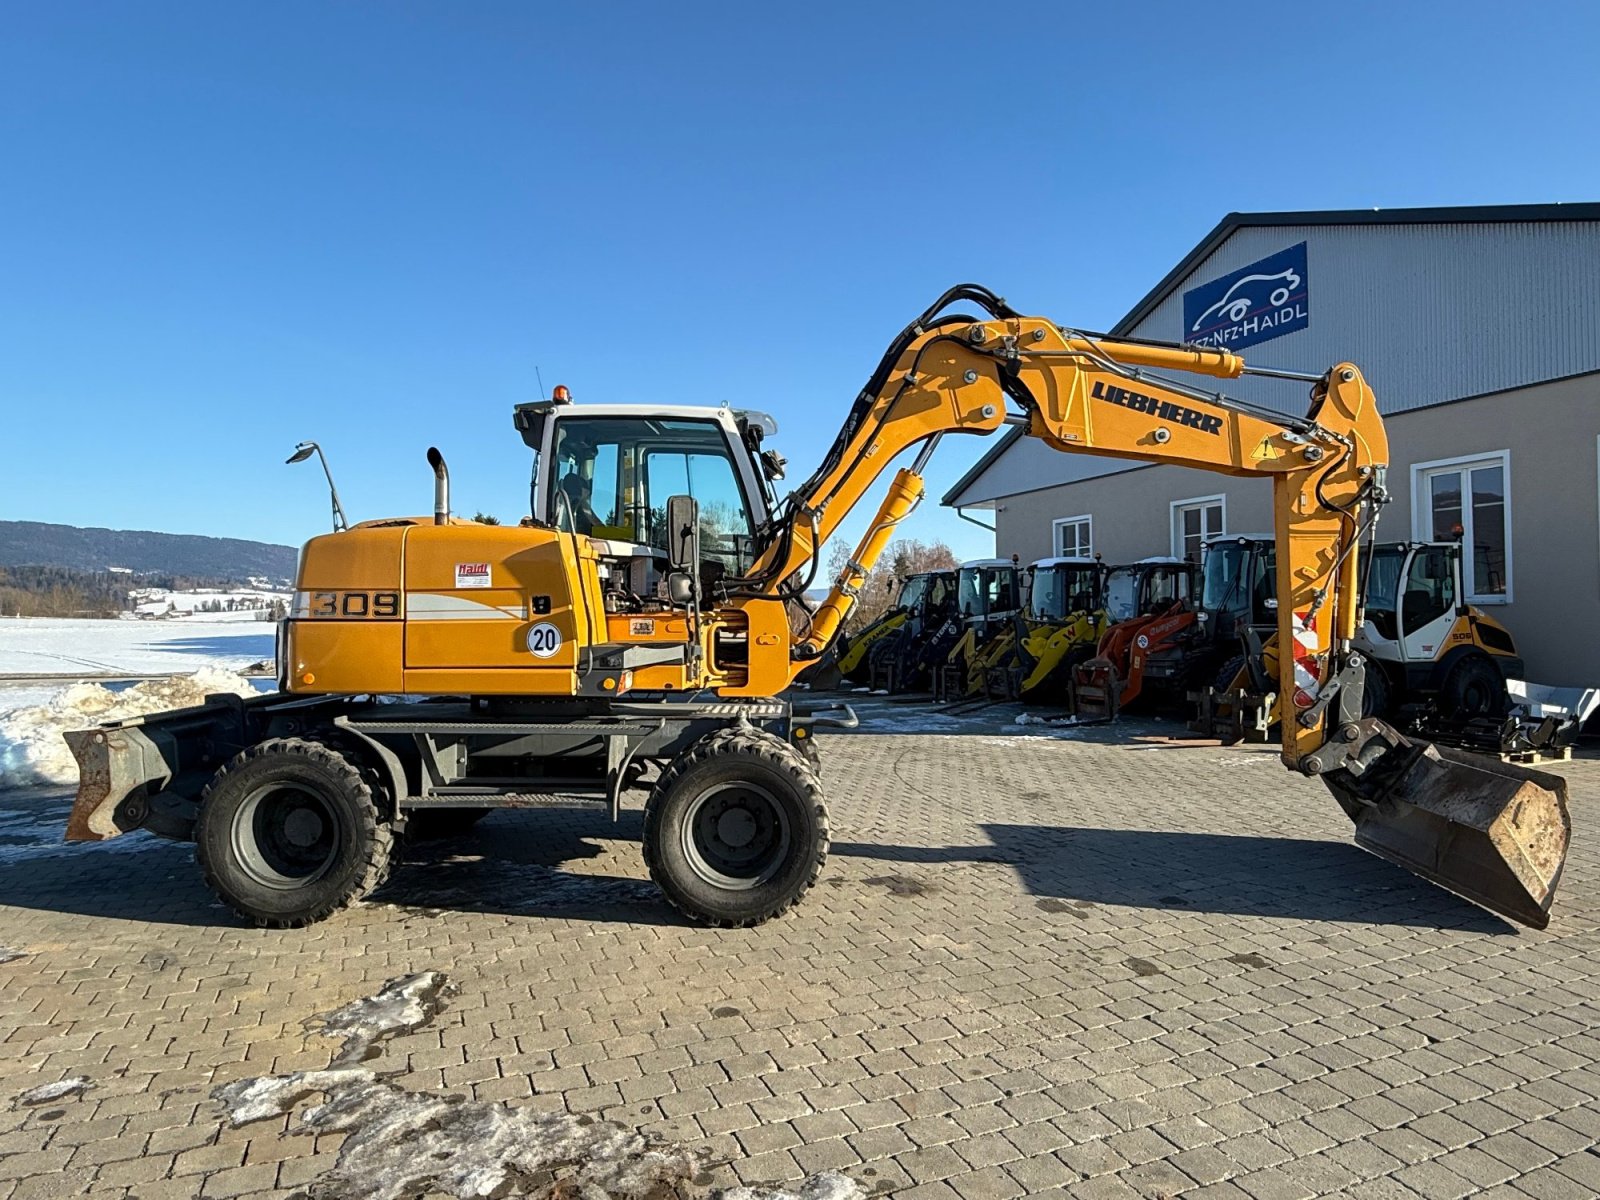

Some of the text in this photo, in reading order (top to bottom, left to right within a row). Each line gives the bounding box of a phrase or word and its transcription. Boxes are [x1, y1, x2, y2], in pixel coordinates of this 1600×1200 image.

[1091, 381, 1223, 436] LIEBHERR
[313, 593, 398, 617] 309
[533, 628, 556, 651] 20
[1138, 636, 1147, 646] 20
